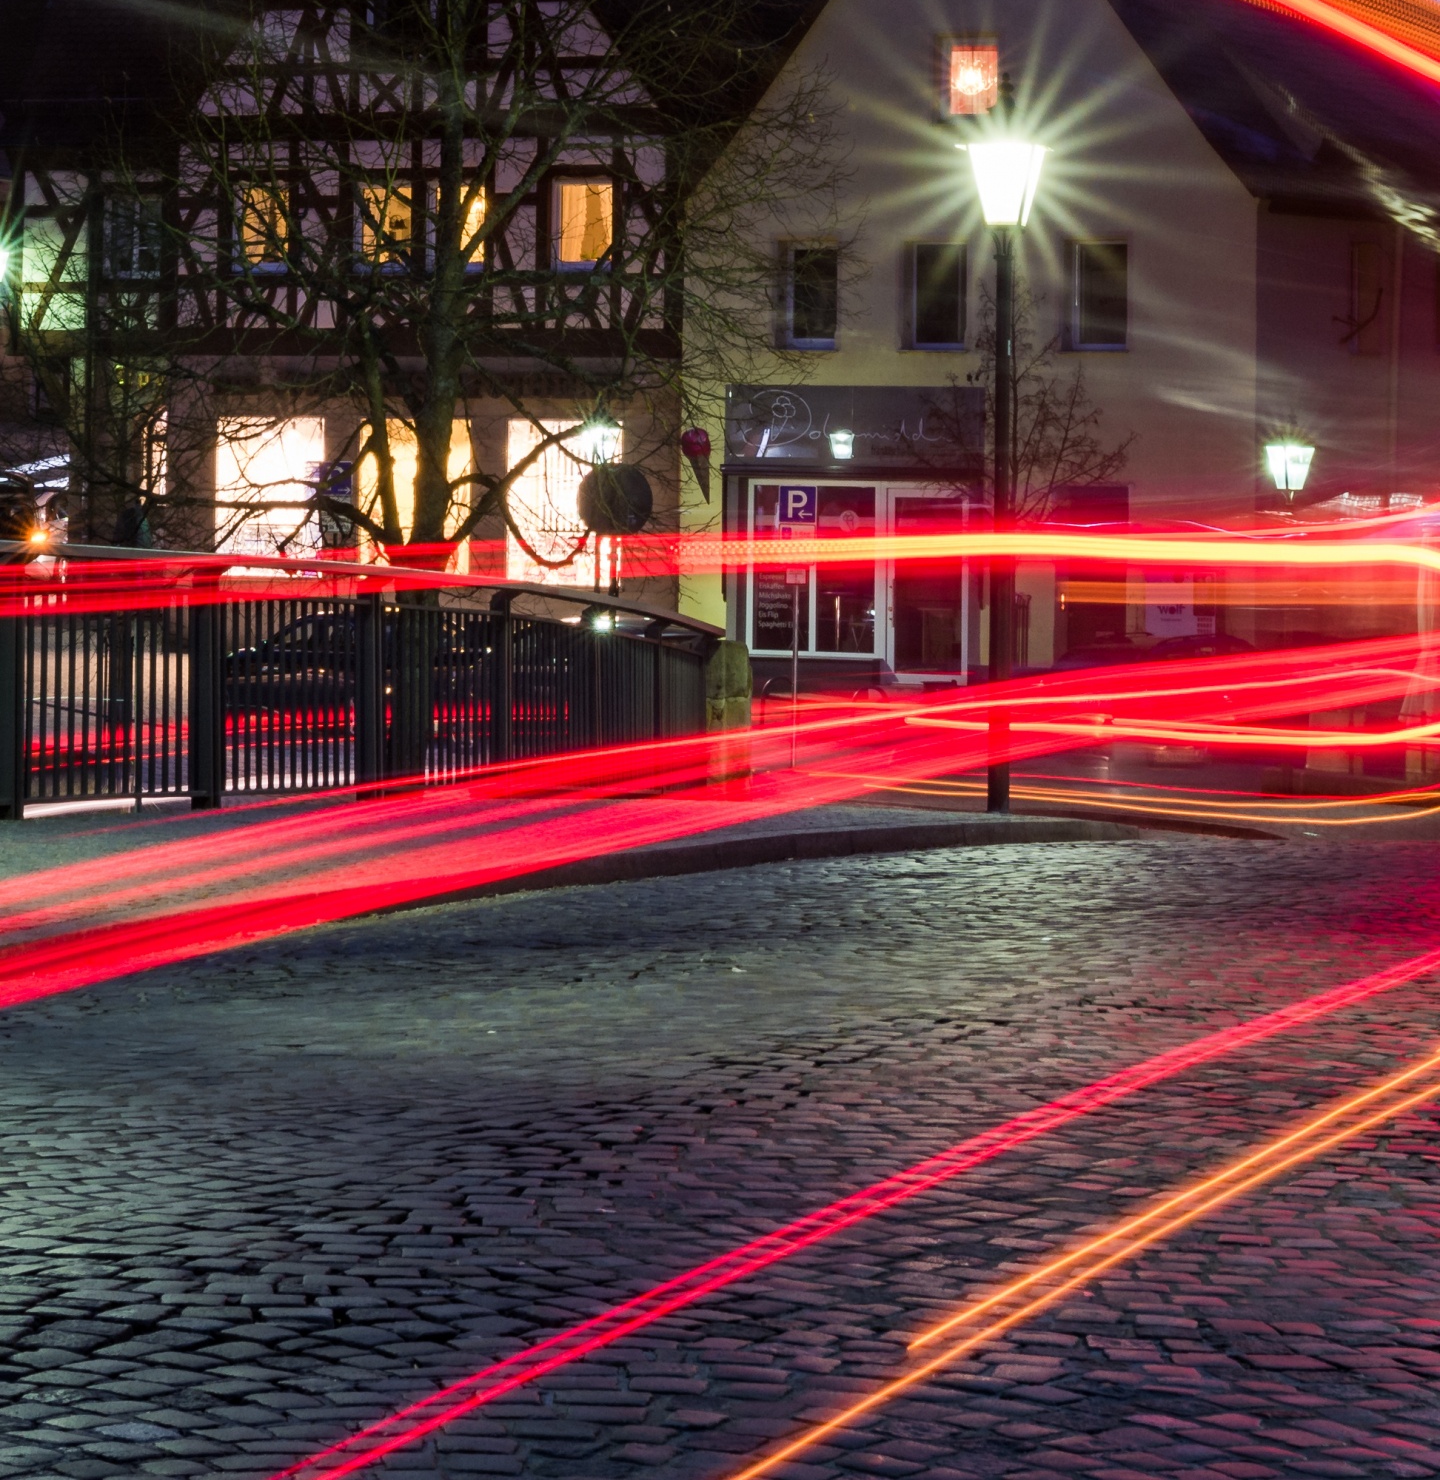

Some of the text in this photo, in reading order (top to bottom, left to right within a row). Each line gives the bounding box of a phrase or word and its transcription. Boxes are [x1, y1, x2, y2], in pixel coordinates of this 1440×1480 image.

[787, 490, 808, 519] P
[1157, 602, 1185, 615] wolf
[767, 611, 779, 619] Flip
[758, 620, 787, 629] Spaghetti
